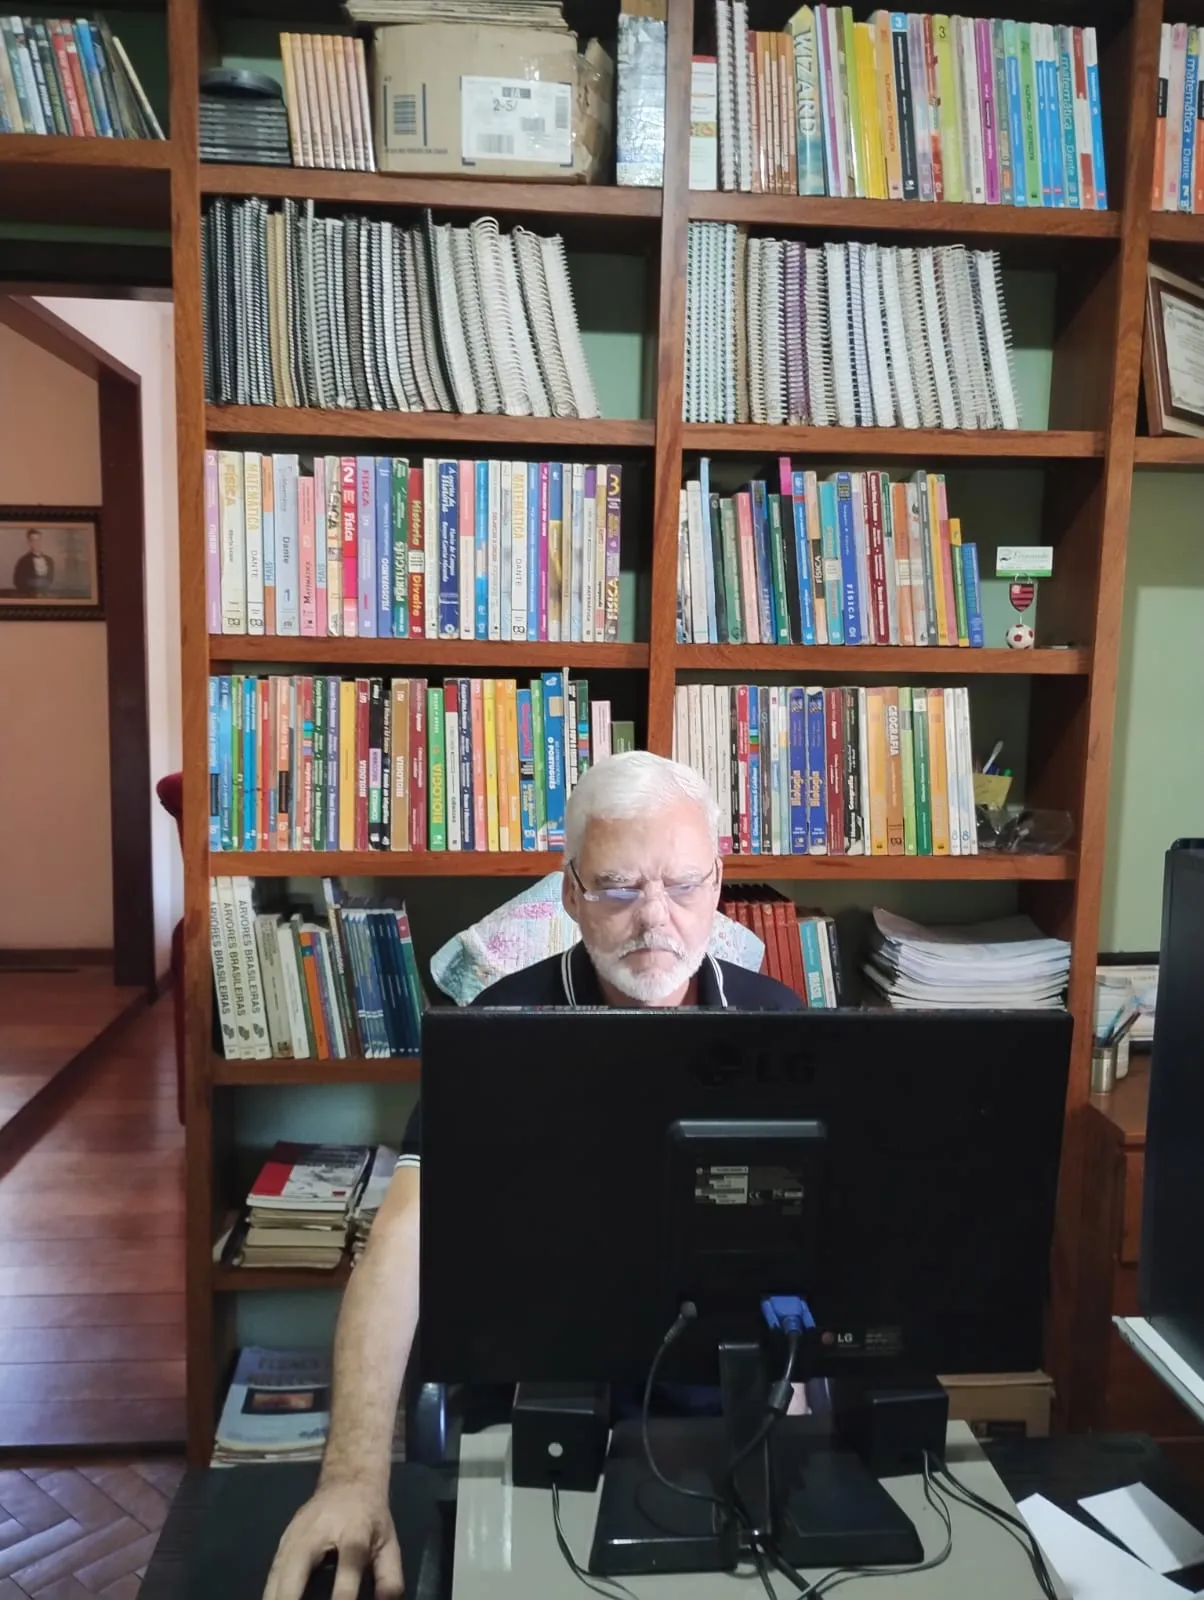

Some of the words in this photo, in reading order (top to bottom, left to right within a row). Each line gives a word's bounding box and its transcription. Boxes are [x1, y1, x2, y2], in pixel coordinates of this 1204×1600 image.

[938, 26, 947, 39] 3
[793, 27, 817, 136] WIZARD
[1061, 55, 1074, 130] matemática
[1183, 58, 1198, 133] matemática
[1066, 145, 1076, 176] Dante
[1181, 147, 1192, 180] Dante
[208, 455, 216, 466] 2
[343, 467, 354, 483] 2
[448, 466, 456, 475] A
[223, 464, 237, 507] FÍSICA
[246, 463, 260, 531] MATEMÁTICA
[361, 469, 370, 507] FÍSICA
[441, 474, 451, 513] História
[609, 475, 620, 496] 3
[411, 499, 423, 546] História
[511, 473, 525, 539] MATEMÁTICA
[344, 511, 356, 542] Física
[250, 550, 258, 579] DANTE
[282, 536, 291, 564] Dante
[813, 555, 823, 584] FÍSICA
[265, 561, 273, 581] MAIS
[381, 557, 390, 611] FILOSOFANDO
[394, 541, 407, 602] PORTUGUÊS
[411, 575, 423, 616] Divalte
[606, 577, 619, 620] FÍSICA
[846, 583, 855, 620] FÍSICA
[888, 704, 900, 756] GEOGRAFIA
[359, 760, 368, 797] BIOLOGIA
[396, 756, 405, 797] BIOLOGIA
[546, 745, 556, 790] PORTUGUÊS
[431, 763, 443, 824] BIOLOGIA
[847, 775, 856, 810] Geografia
[213, 949, 231, 1015] BRASILEIRAS
[229, 951, 246, 1017] BRASILEIRAS
[243, 949, 261, 1014] BRASILEIRAS
[837, 1332, 853, 1344] LG
